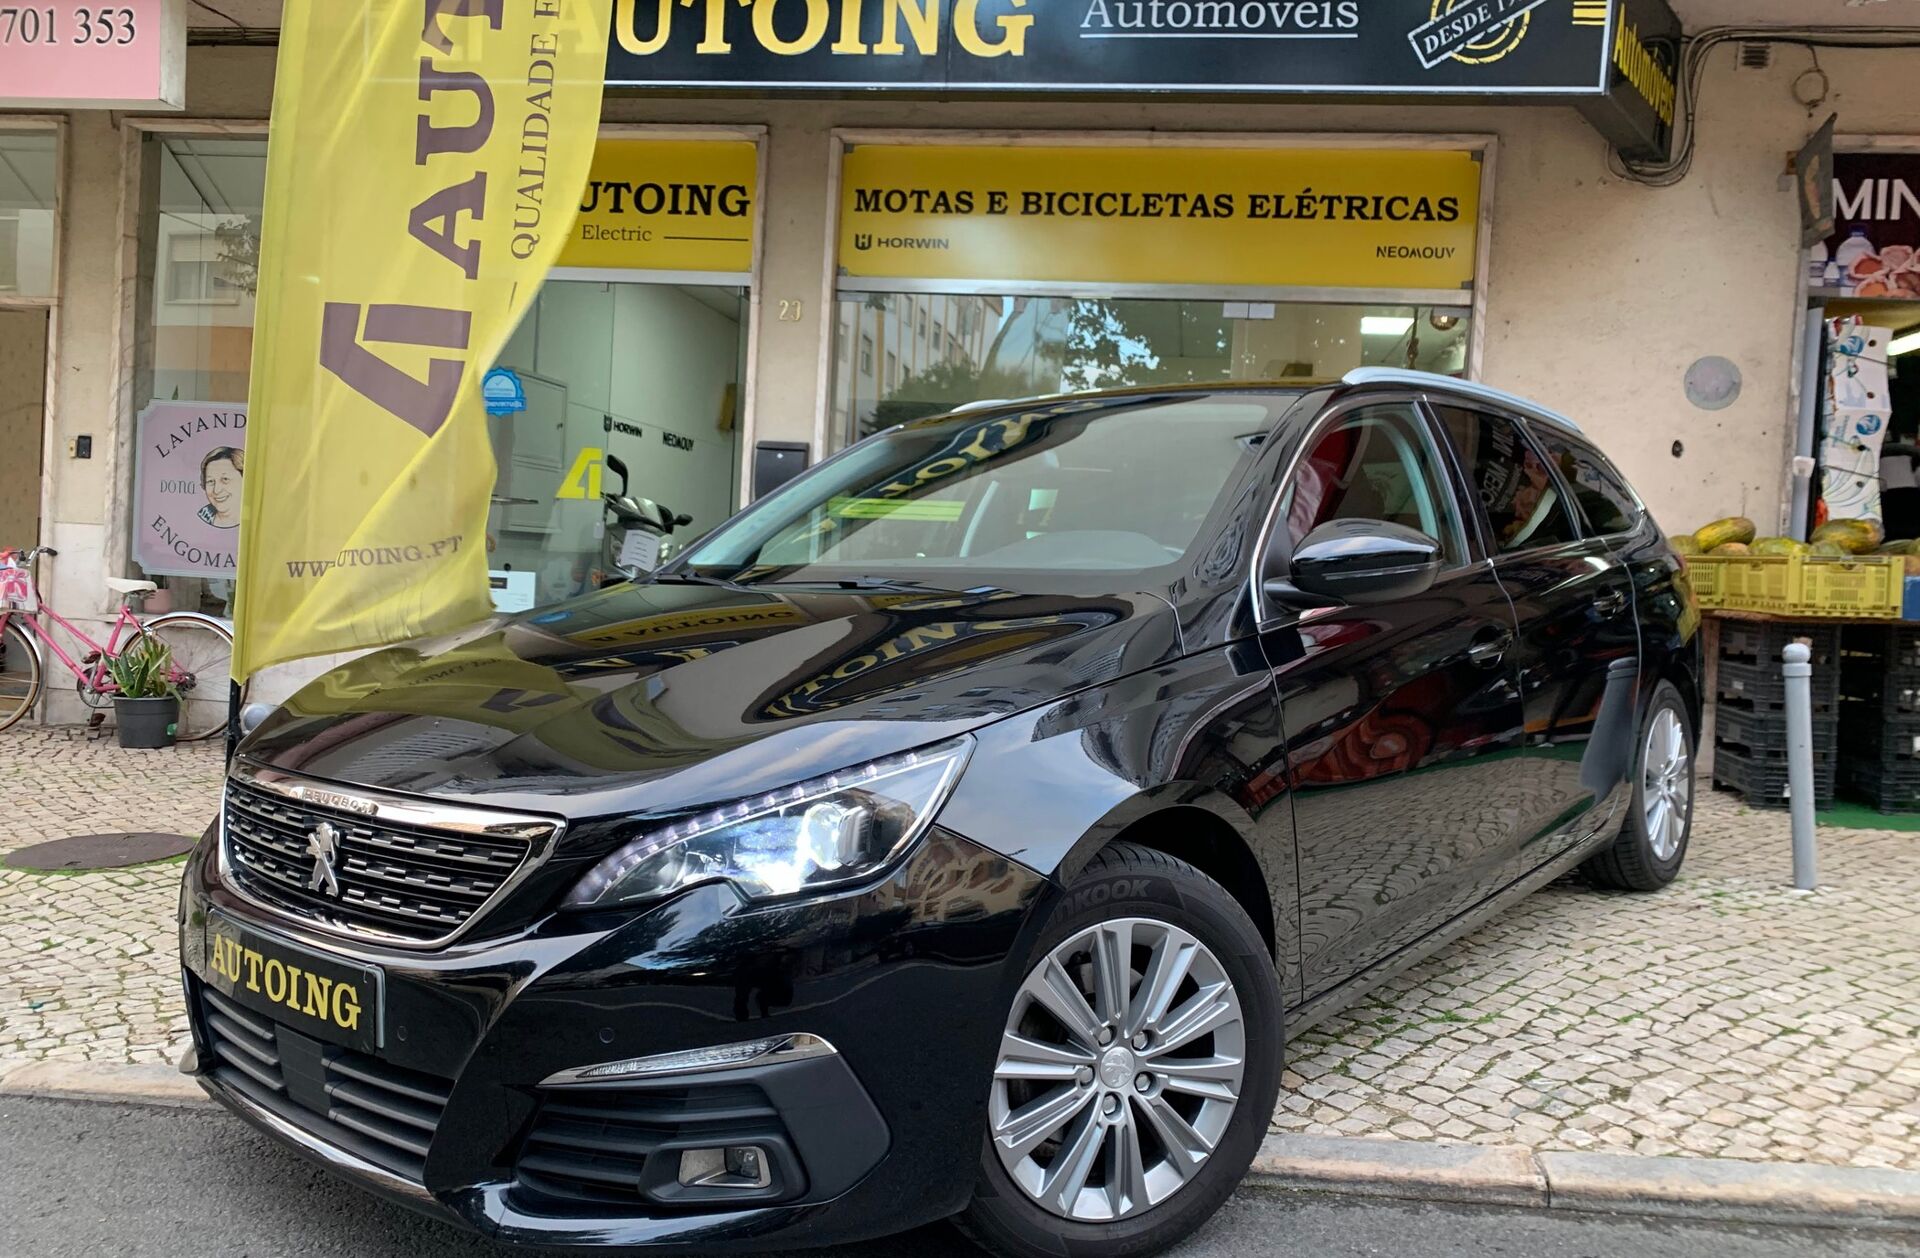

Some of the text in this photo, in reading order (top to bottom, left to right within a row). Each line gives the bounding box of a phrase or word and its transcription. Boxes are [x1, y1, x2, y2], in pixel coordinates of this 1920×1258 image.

[1, 8, 136, 44] 701 353
[1423, 3, 1492, 55] DESDE
[510, 34, 558, 260] QUALIDADE
[853, 187, 1460, 222] MOTAS E BICICLETAS ELÉTRICAS
[582, 224, 652, 242] Electric
[877, 237, 950, 250] HORWIN
[613, 421, 643, 438] HORWIN
[151, 515, 236, 569] ENGOMA
[211, 933, 362, 1031] AUTOING
